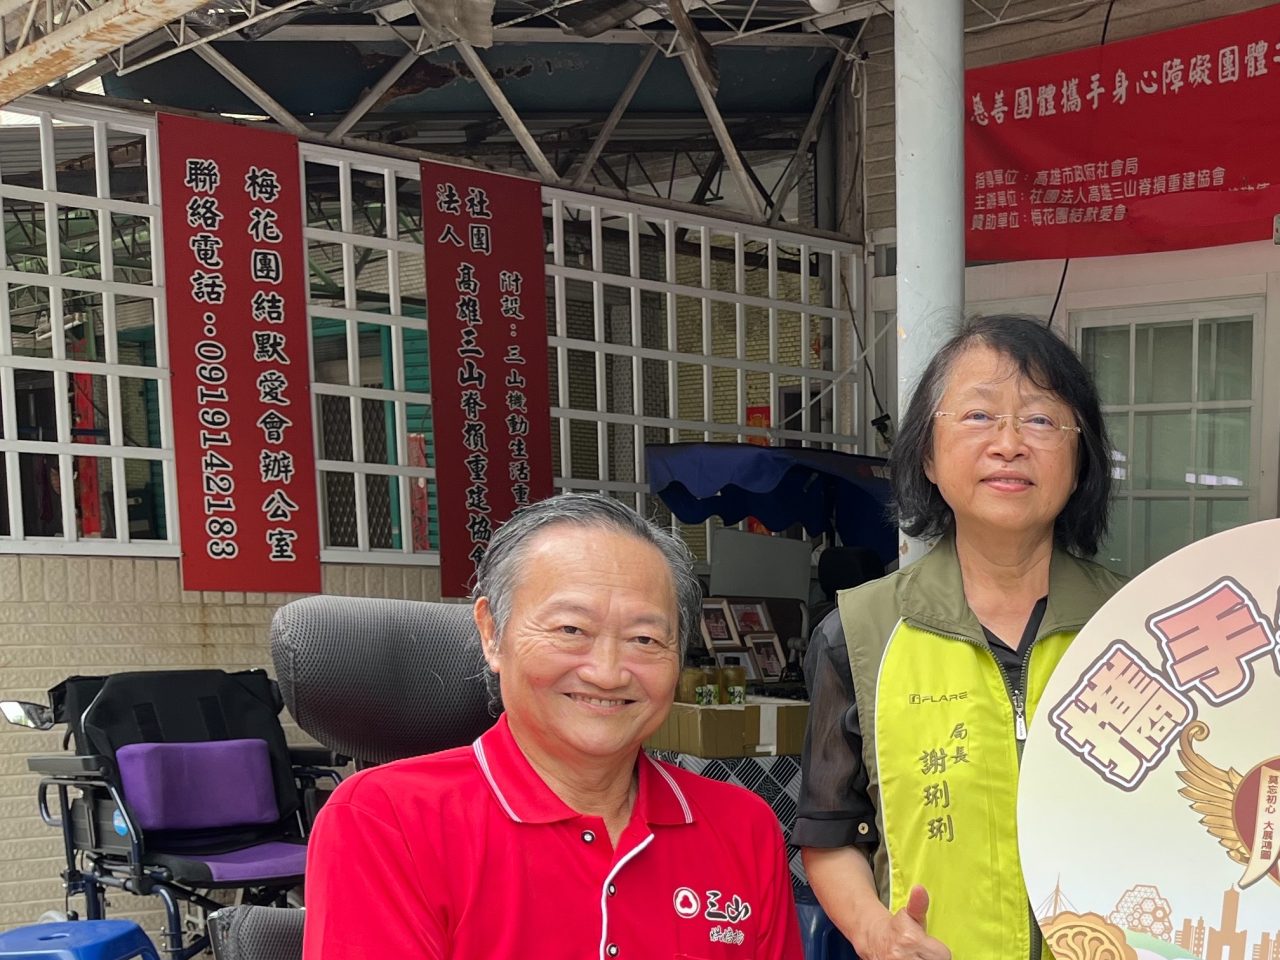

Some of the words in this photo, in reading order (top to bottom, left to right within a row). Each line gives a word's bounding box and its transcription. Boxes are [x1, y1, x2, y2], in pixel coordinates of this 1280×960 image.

[245, 167, 299, 563] 梅花團結默愛會辦公室
[499, 270, 531, 516] 附設：三山機動生活重
[919, 747, 955, 842] 謝琍琍
[950, 722, 970, 764] 局長
